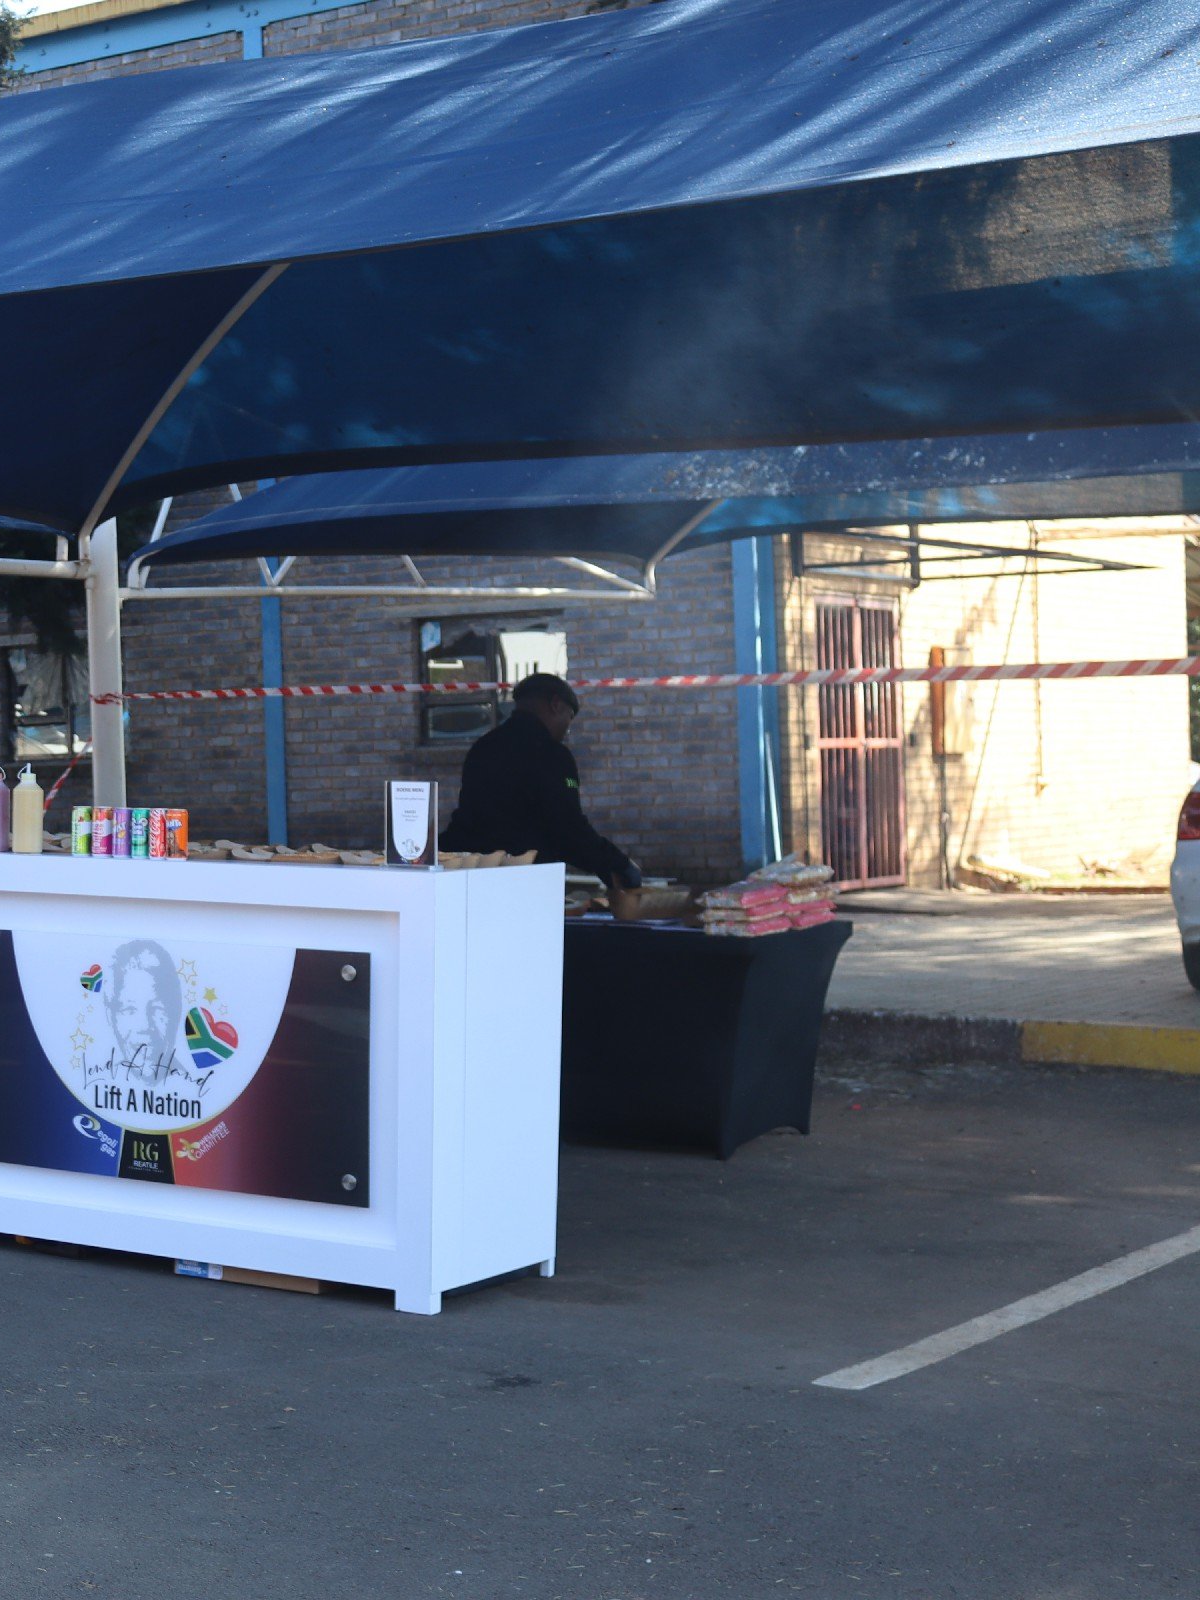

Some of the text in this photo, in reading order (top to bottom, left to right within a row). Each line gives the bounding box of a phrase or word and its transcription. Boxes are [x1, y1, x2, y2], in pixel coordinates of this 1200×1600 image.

[82, 1047, 116, 1090] Lend
[149, 1048, 215, 1097] Hand
[94, 1085, 202, 1119] Lift A Nation
[97, 1130, 118, 1149] egoli
[100, 1143, 116, 1158] gas
[133, 1140, 159, 1161] RG
